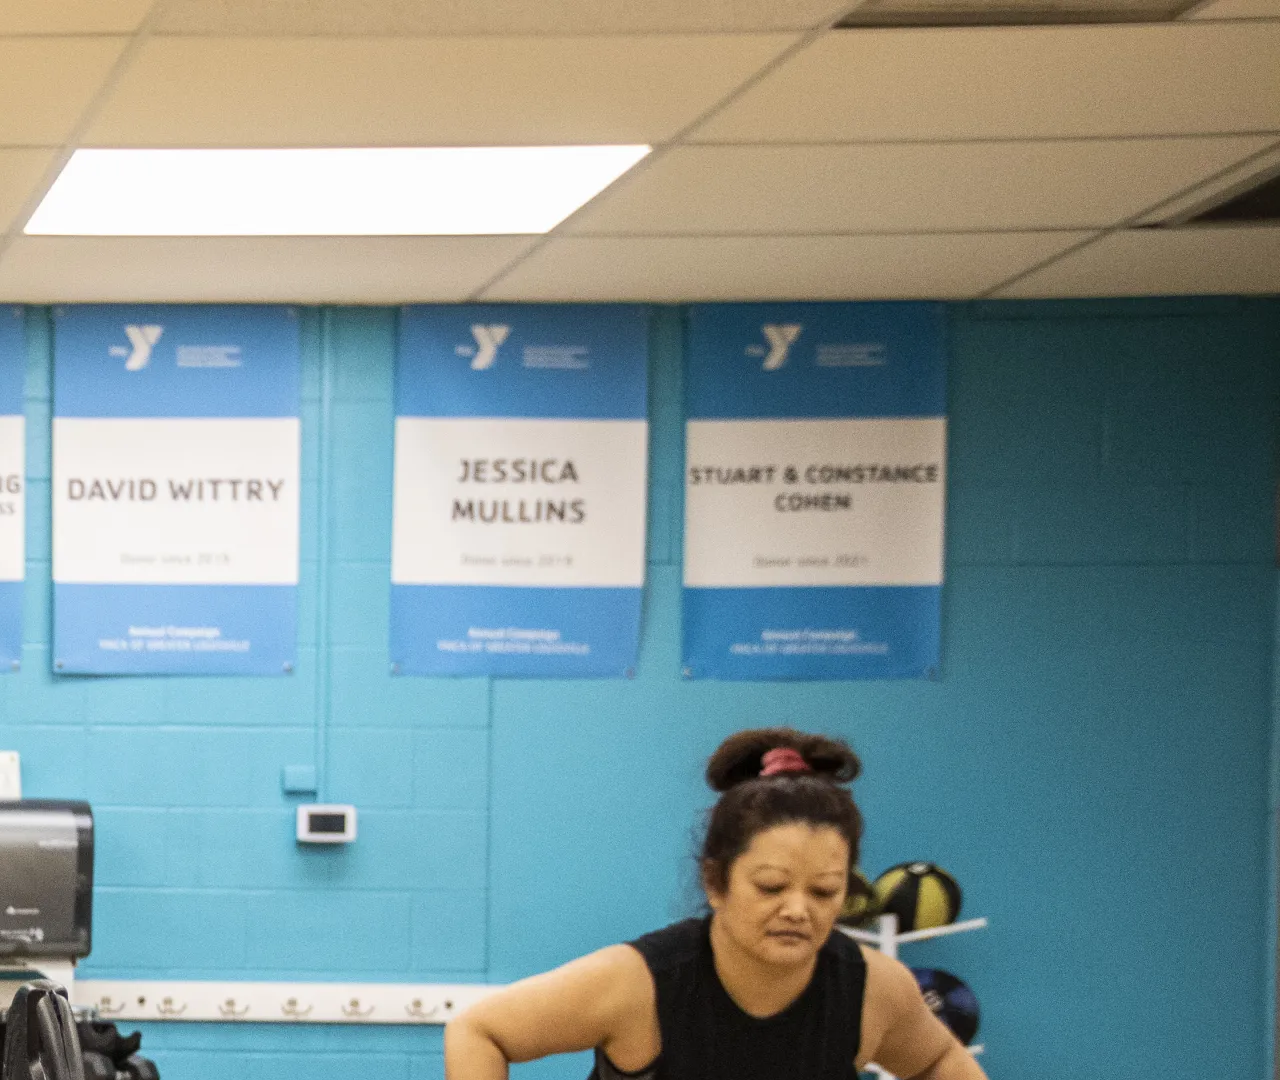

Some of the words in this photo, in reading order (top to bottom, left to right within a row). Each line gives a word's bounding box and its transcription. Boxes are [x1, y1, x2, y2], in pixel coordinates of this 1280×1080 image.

[458, 458, 580, 485] JESSICA
[689, 465, 776, 485] STUART
[783, 465, 799, 485] &
[805, 464, 938, 484] CONSTANCE
[67, 477, 158, 502] DAVID
[167, 478, 284, 502] WITTRY
[774, 492, 853, 512] COHEN
[451, 498, 587, 525] MULLINS
